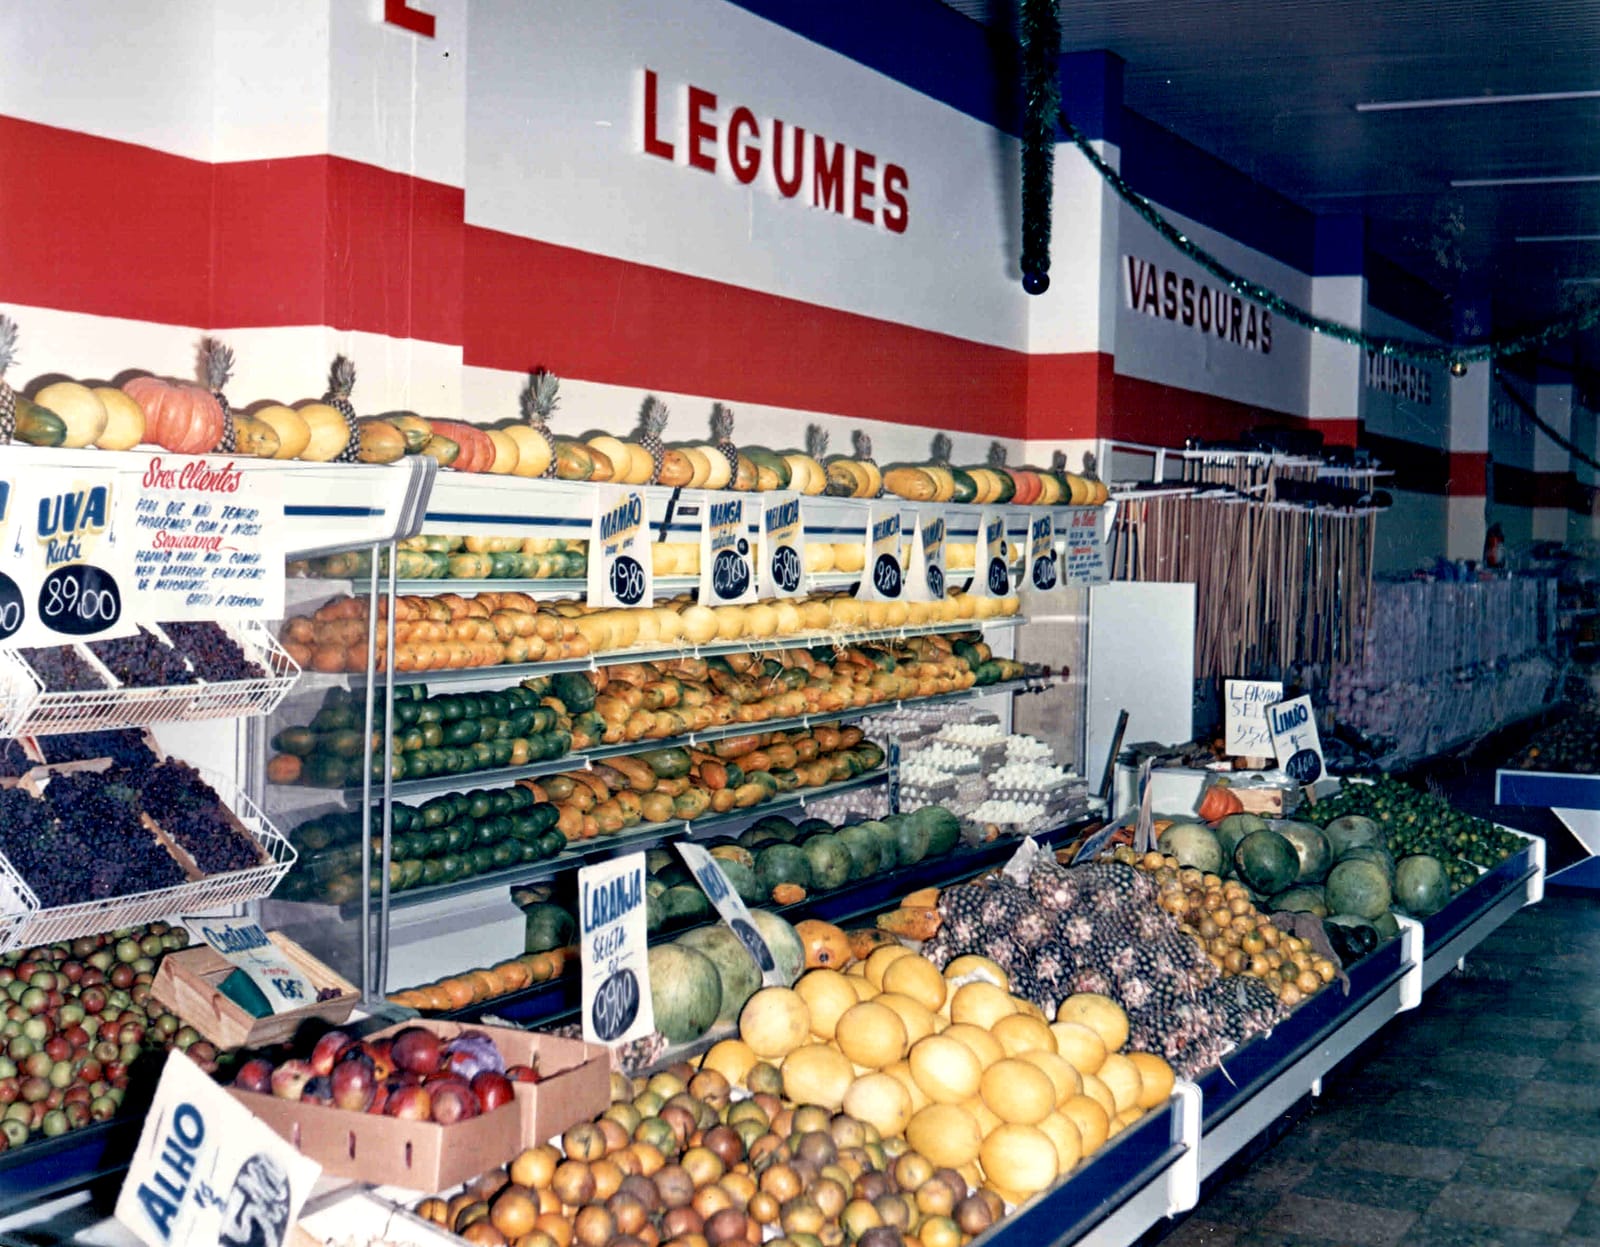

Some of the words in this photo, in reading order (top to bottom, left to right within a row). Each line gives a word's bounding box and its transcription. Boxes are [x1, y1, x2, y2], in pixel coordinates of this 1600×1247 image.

[643, 68, 910, 235] LEGUMES
[1127, 255, 1272, 354] VASSOURAS
[142, 457, 176, 489] Sres
[179, 460, 243, 493] Clientes
[38, 486, 107, 536] UVA
[600, 492, 642, 540] MAMÃO
[710, 499, 742, 528] MANGA
[46, 534, 82, 566] Rubi
[45, 576, 116, 620] 89,00
[1272, 703, 1309, 735] LIMÃO
[583, 869, 642, 934] LARANJA
[592, 926, 626, 964] SELETA
[137, 1102, 206, 1241] ALHO
